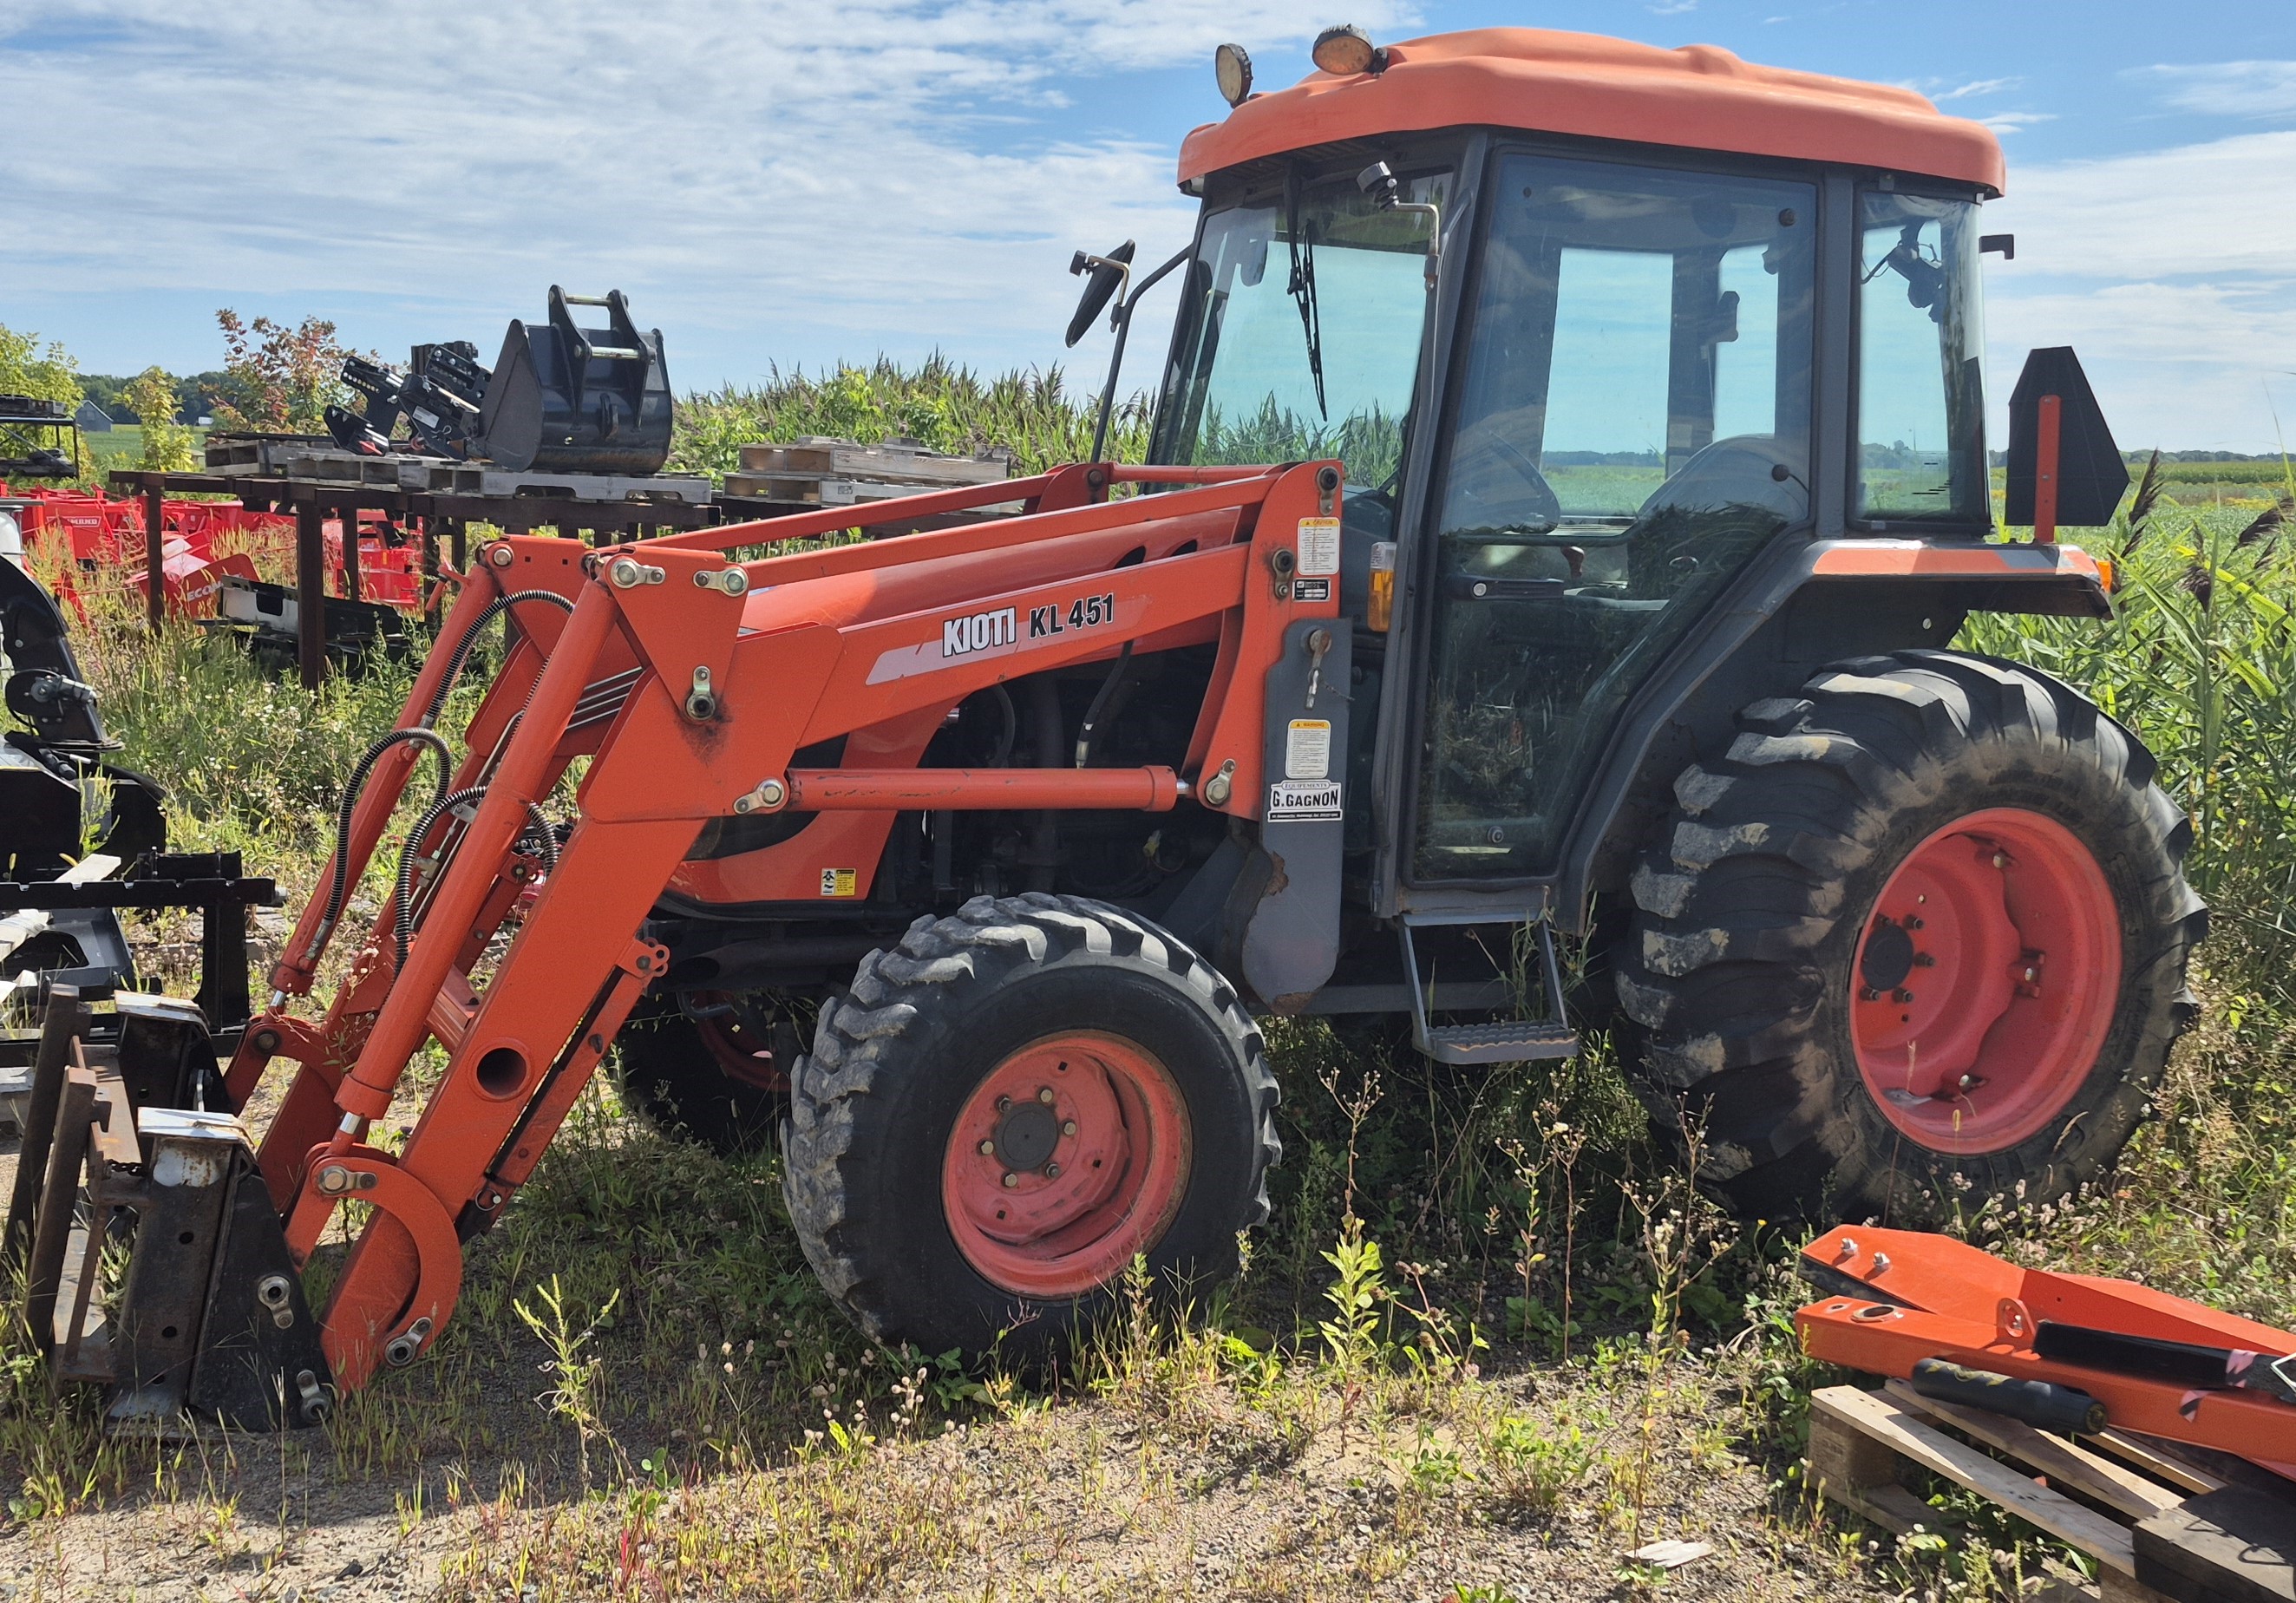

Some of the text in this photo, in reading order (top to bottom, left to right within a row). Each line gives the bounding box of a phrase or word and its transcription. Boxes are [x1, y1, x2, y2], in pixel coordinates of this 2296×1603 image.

[943, 592, 1115, 658] KIOTI KL 451
